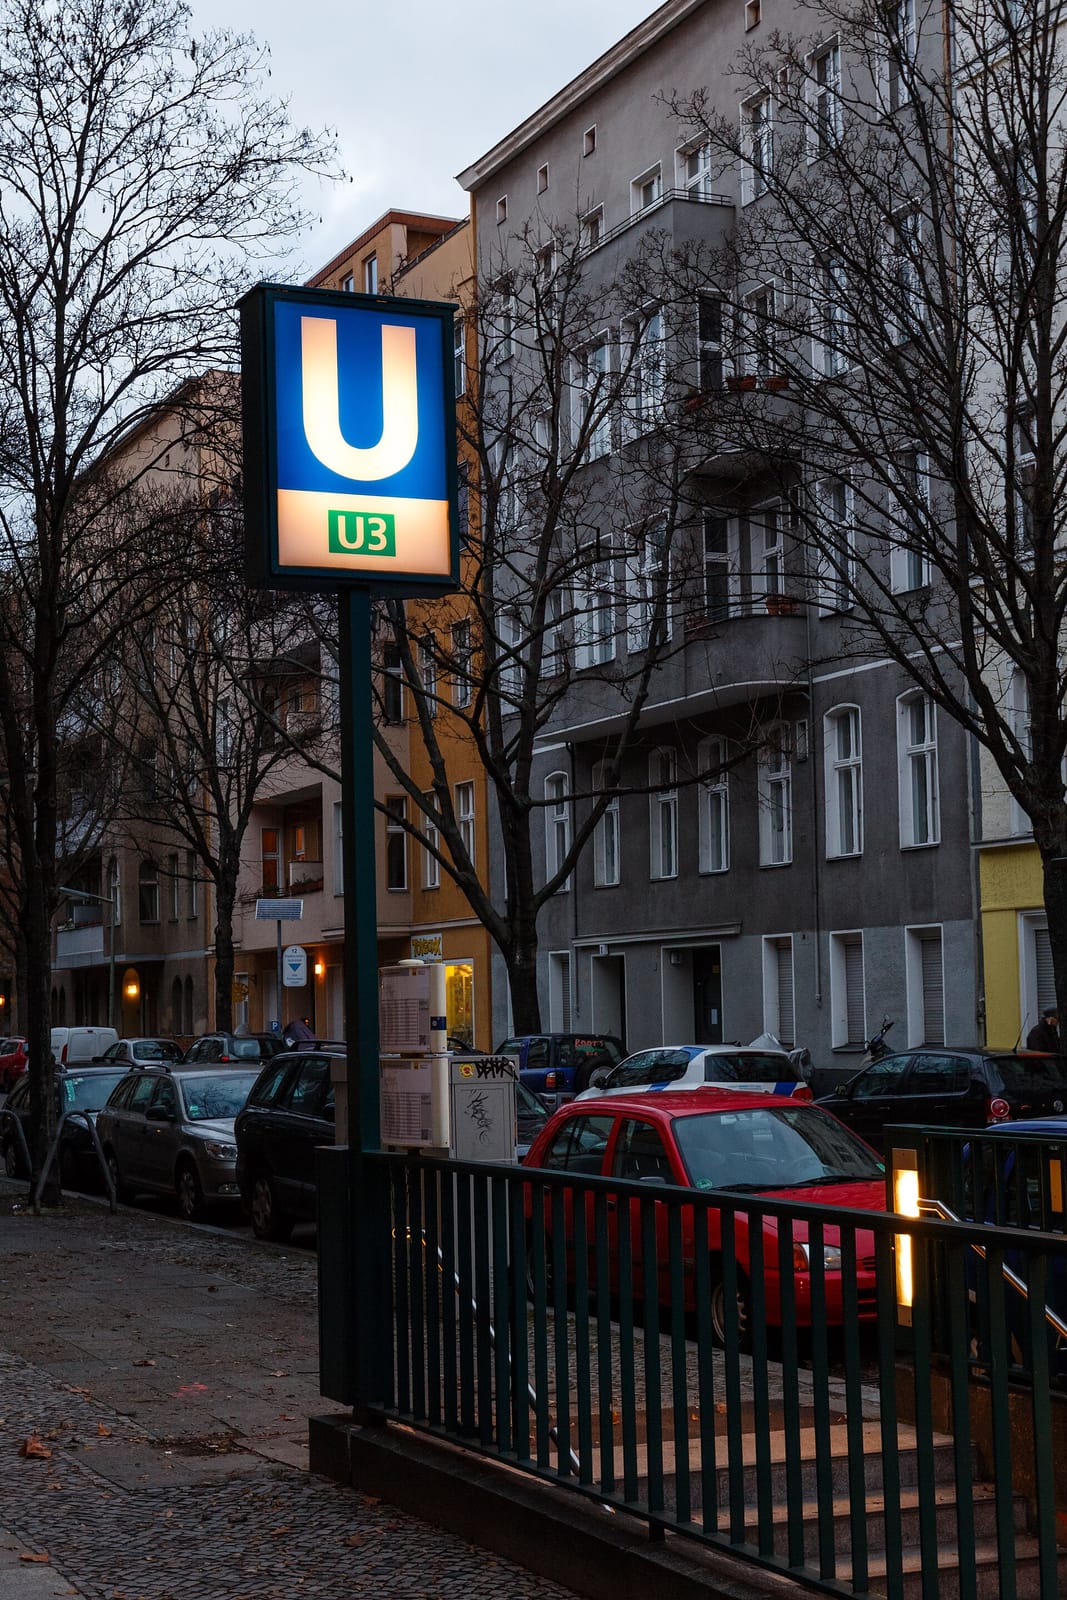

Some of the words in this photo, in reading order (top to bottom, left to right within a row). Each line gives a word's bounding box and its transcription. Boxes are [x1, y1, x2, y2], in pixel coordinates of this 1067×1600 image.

[301, 316, 418, 481] U
[337, 514, 388, 552] U3
[272, 1022, 278, 1030] P
